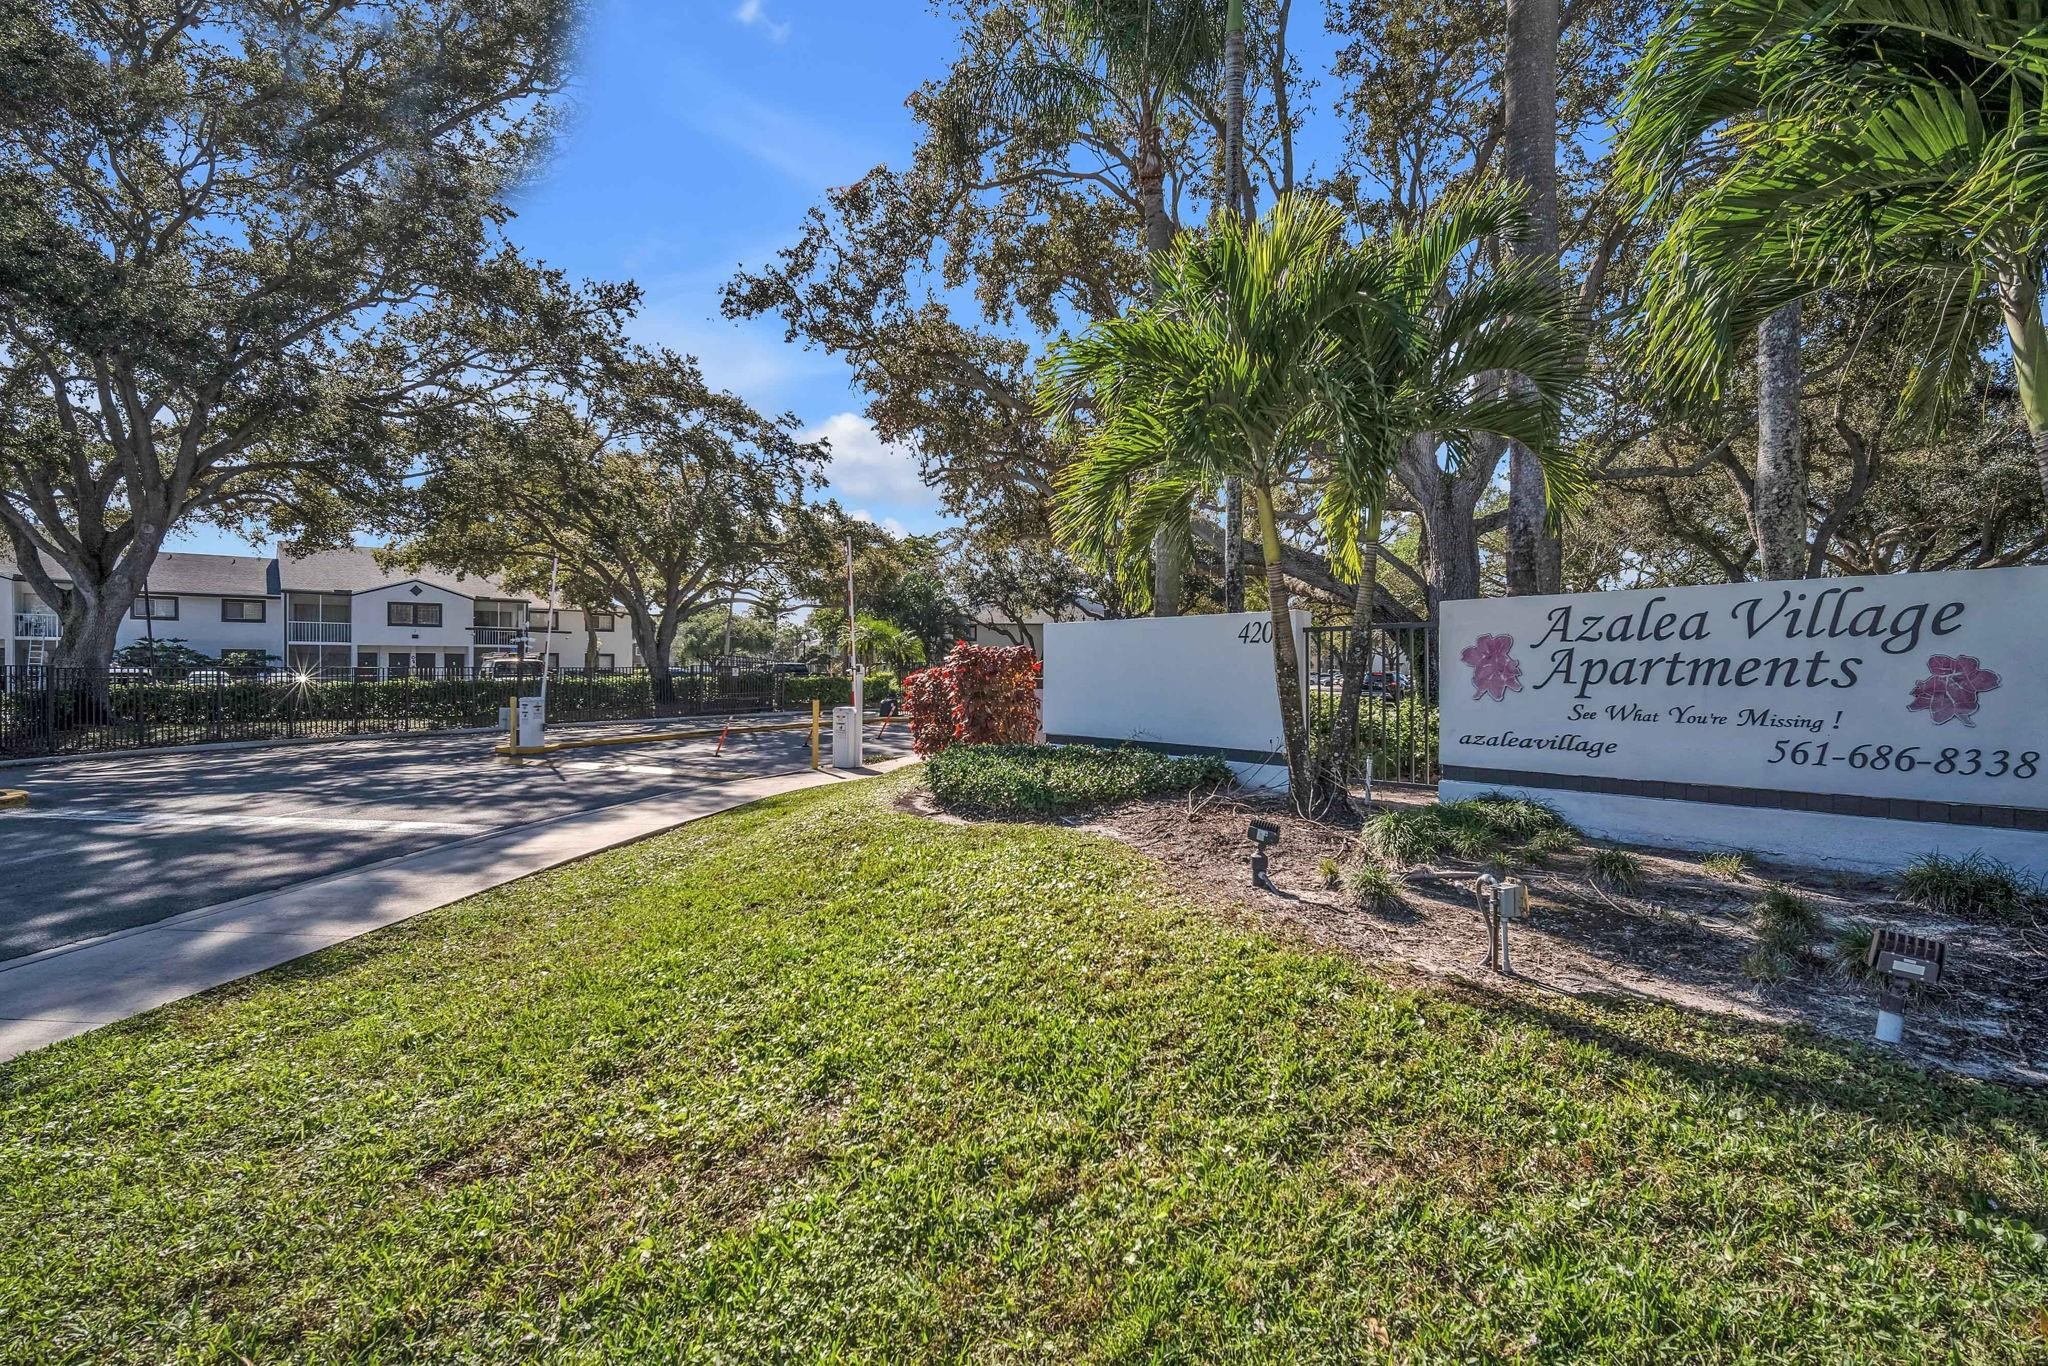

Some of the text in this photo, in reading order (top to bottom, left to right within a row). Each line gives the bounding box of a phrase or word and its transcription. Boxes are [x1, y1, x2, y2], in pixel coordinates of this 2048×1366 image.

[1530, 586, 1965, 655] Azalea Village
[1532, 647, 1863, 699] Apartments
[1567, 703, 1597, 721] See
[1604, 703, 1660, 722] What
[1668, 705, 1728, 725] You're
[1736, 708, 1825, 733] Missing
[1459, 730, 1618, 759] azaleavillage
[1767, 739, 2041, 780] 561-686-8338
